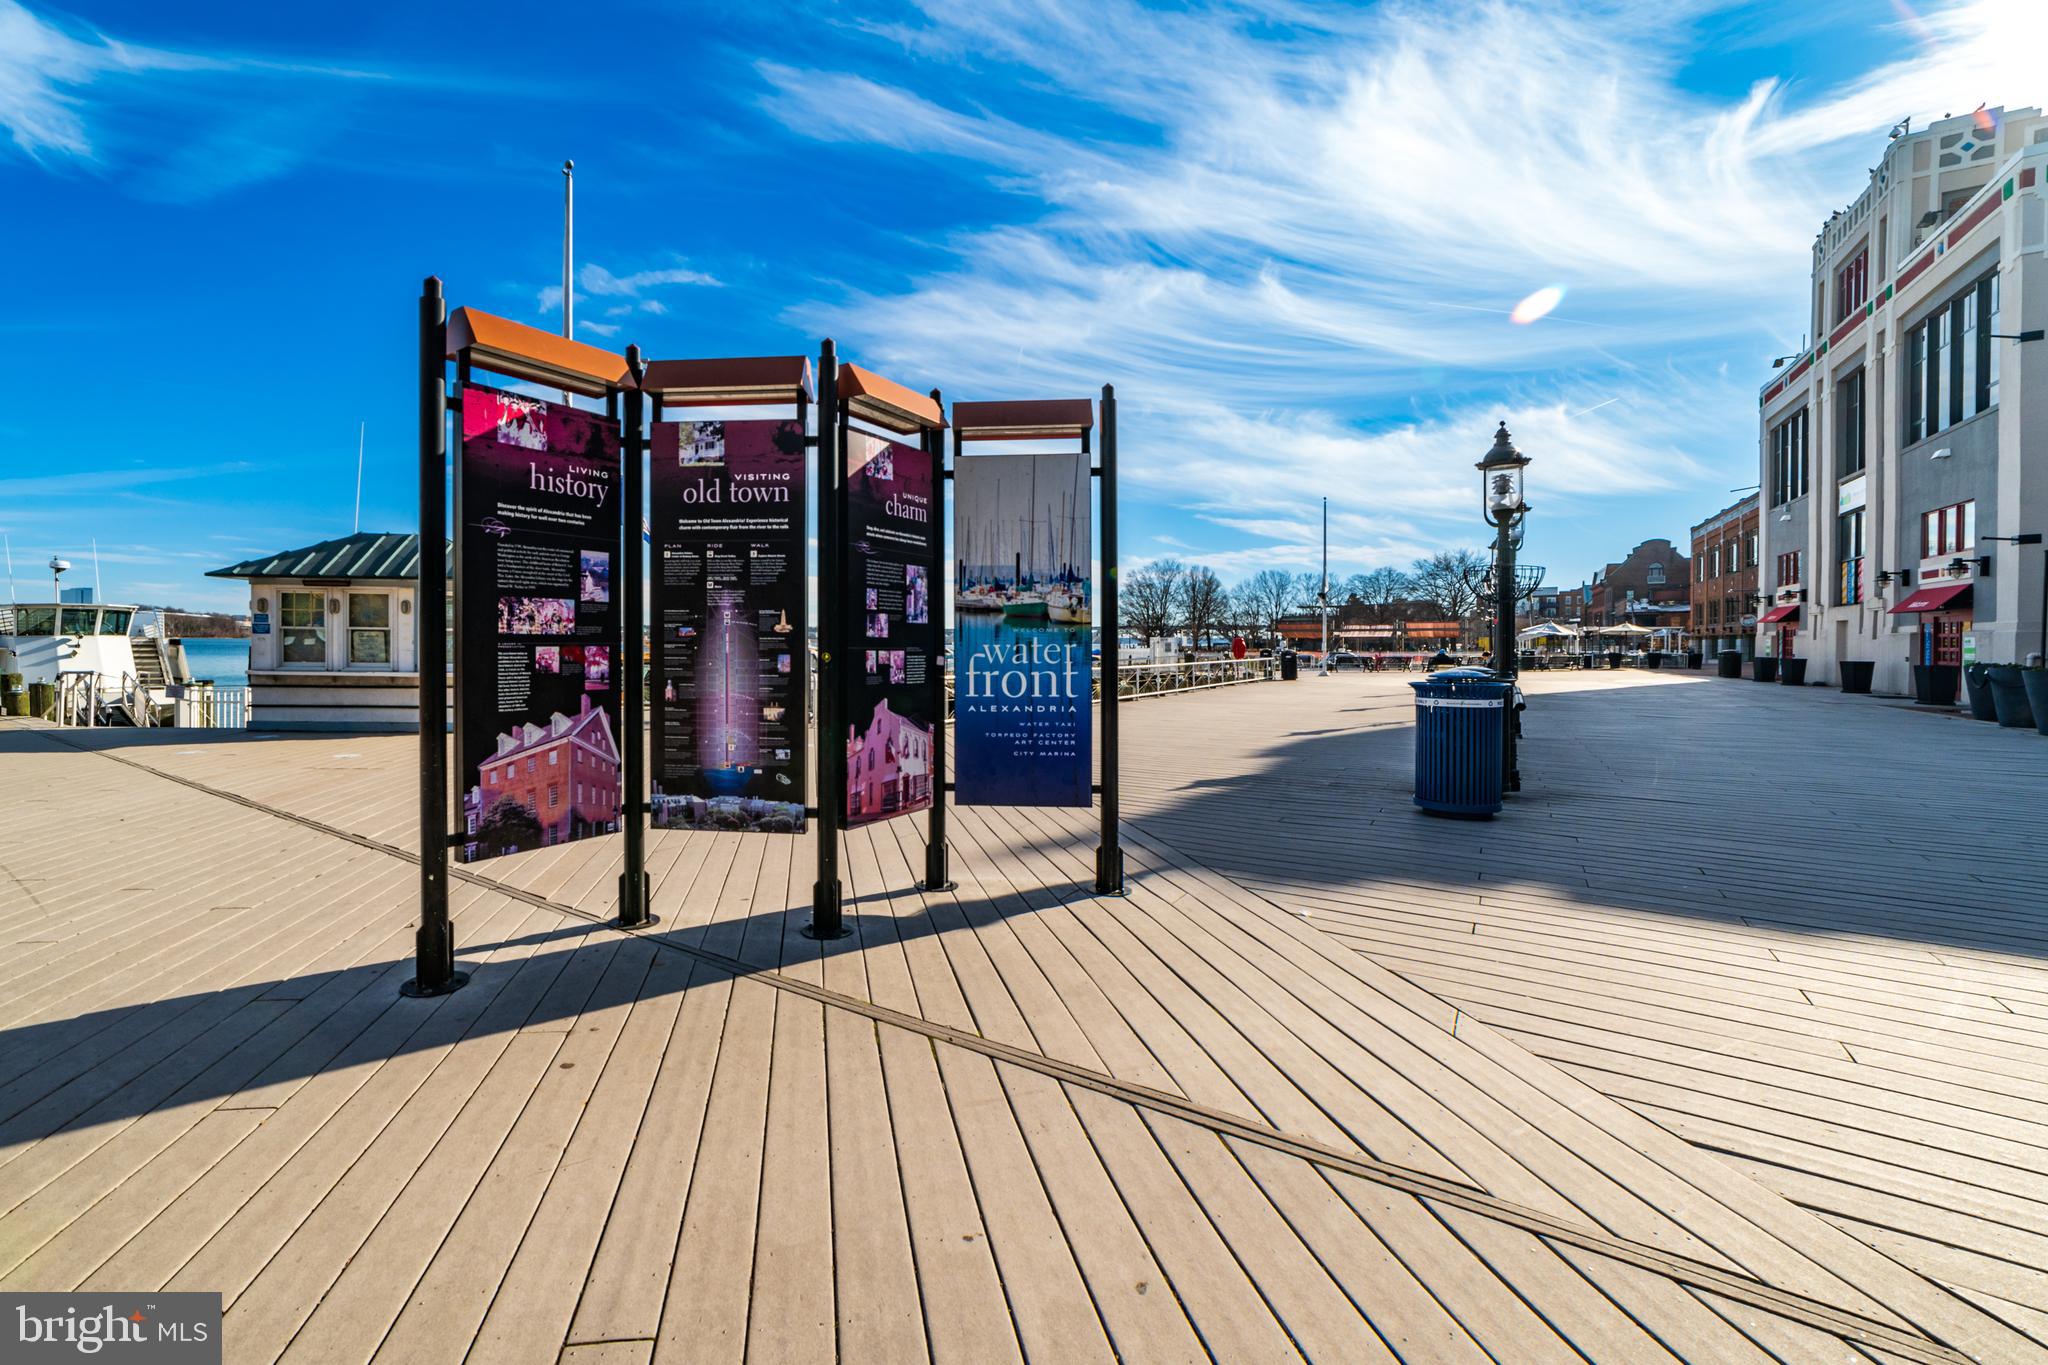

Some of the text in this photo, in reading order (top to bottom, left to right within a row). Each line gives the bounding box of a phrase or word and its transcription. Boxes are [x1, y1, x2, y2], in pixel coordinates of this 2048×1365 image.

[530, 462, 608, 508] history
[569, 465, 608, 478] LIVING
[683, 478, 790, 503] old town
[902, 492, 928, 504] UNIQUE
[886, 493, 927, 522] charm
[982, 636, 1077, 664] water
[965, 653, 1079, 698] front
